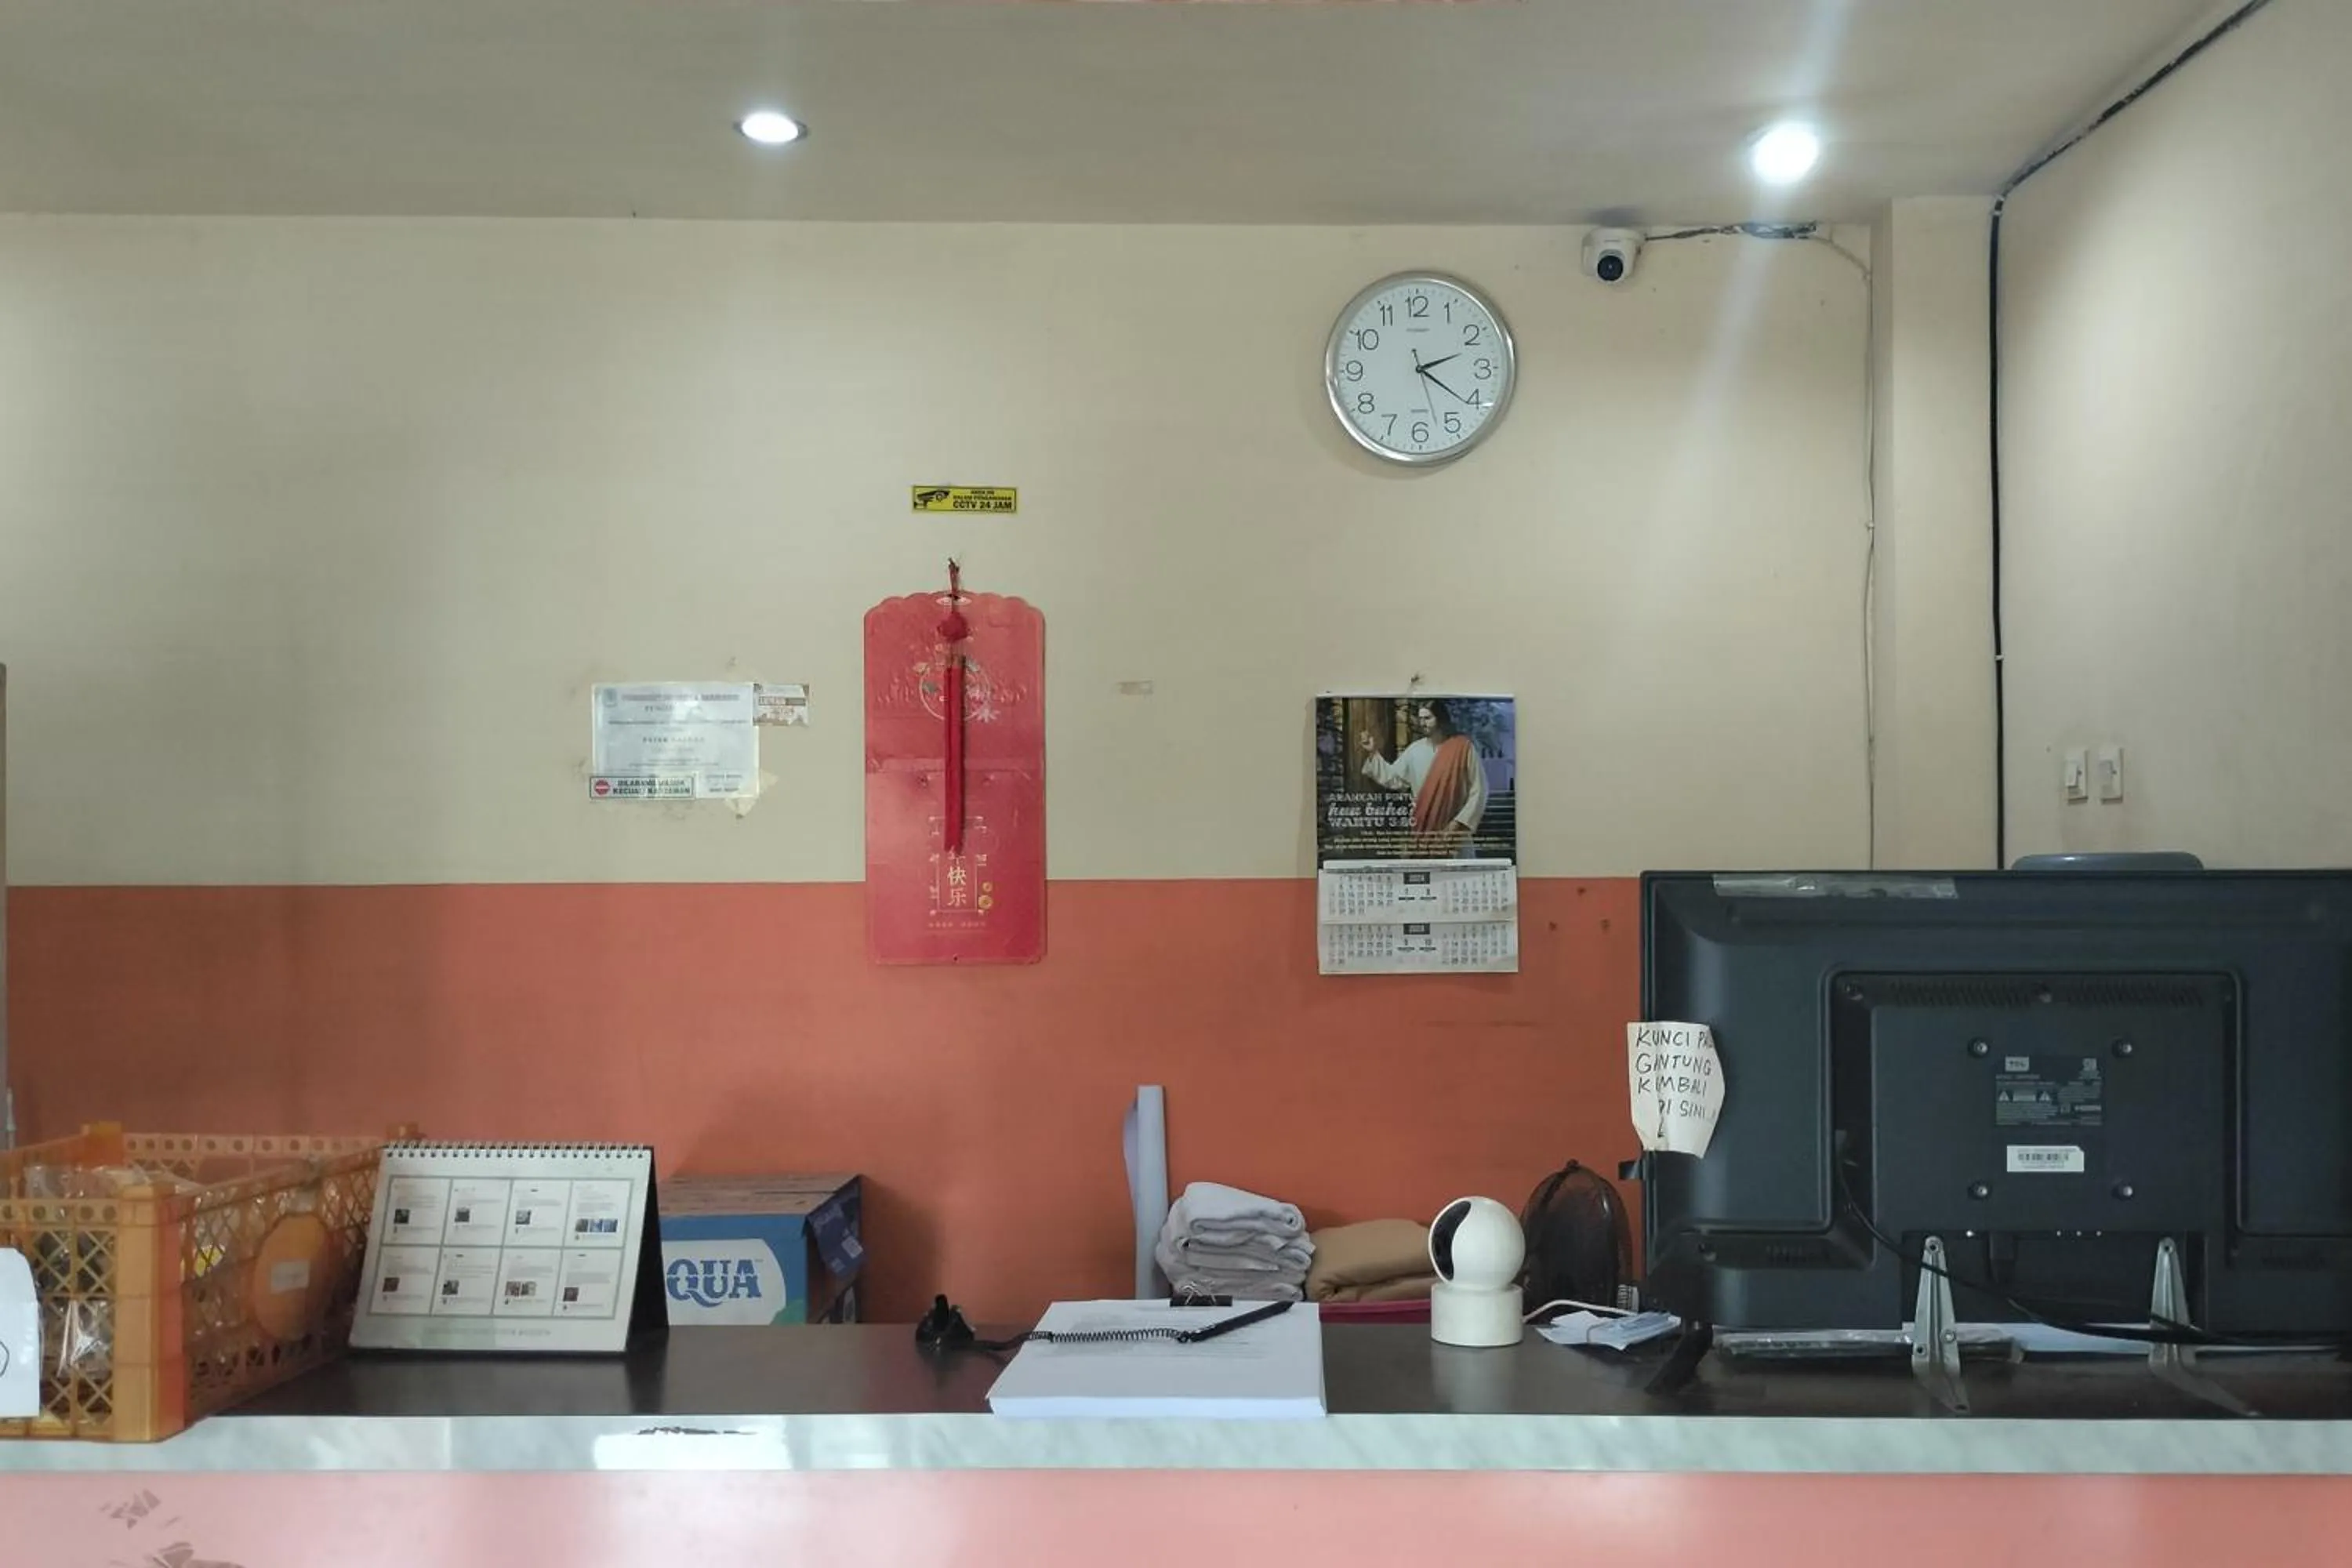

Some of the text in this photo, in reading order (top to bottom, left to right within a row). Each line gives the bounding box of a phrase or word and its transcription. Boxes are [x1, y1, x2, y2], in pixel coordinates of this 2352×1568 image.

[1380, 304, 1393, 326] 11
[1406, 296, 1429, 318] 12
[1444, 302, 1450, 325] 1
[1356, 328, 1379, 350] 10
[1463, 324, 1480, 346] 2
[1346, 360, 1363, 382] 9
[1473, 358, 1491, 379] 3
[1357, 392, 1375, 414] 8
[1465, 388, 1482, 409] 4
[1381, 413, 1398, 436] 7
[1411, 422, 1429, 443] 6
[1443, 412, 1461, 434] 5
[1635, 1025, 1690, 1047] KUNCI
